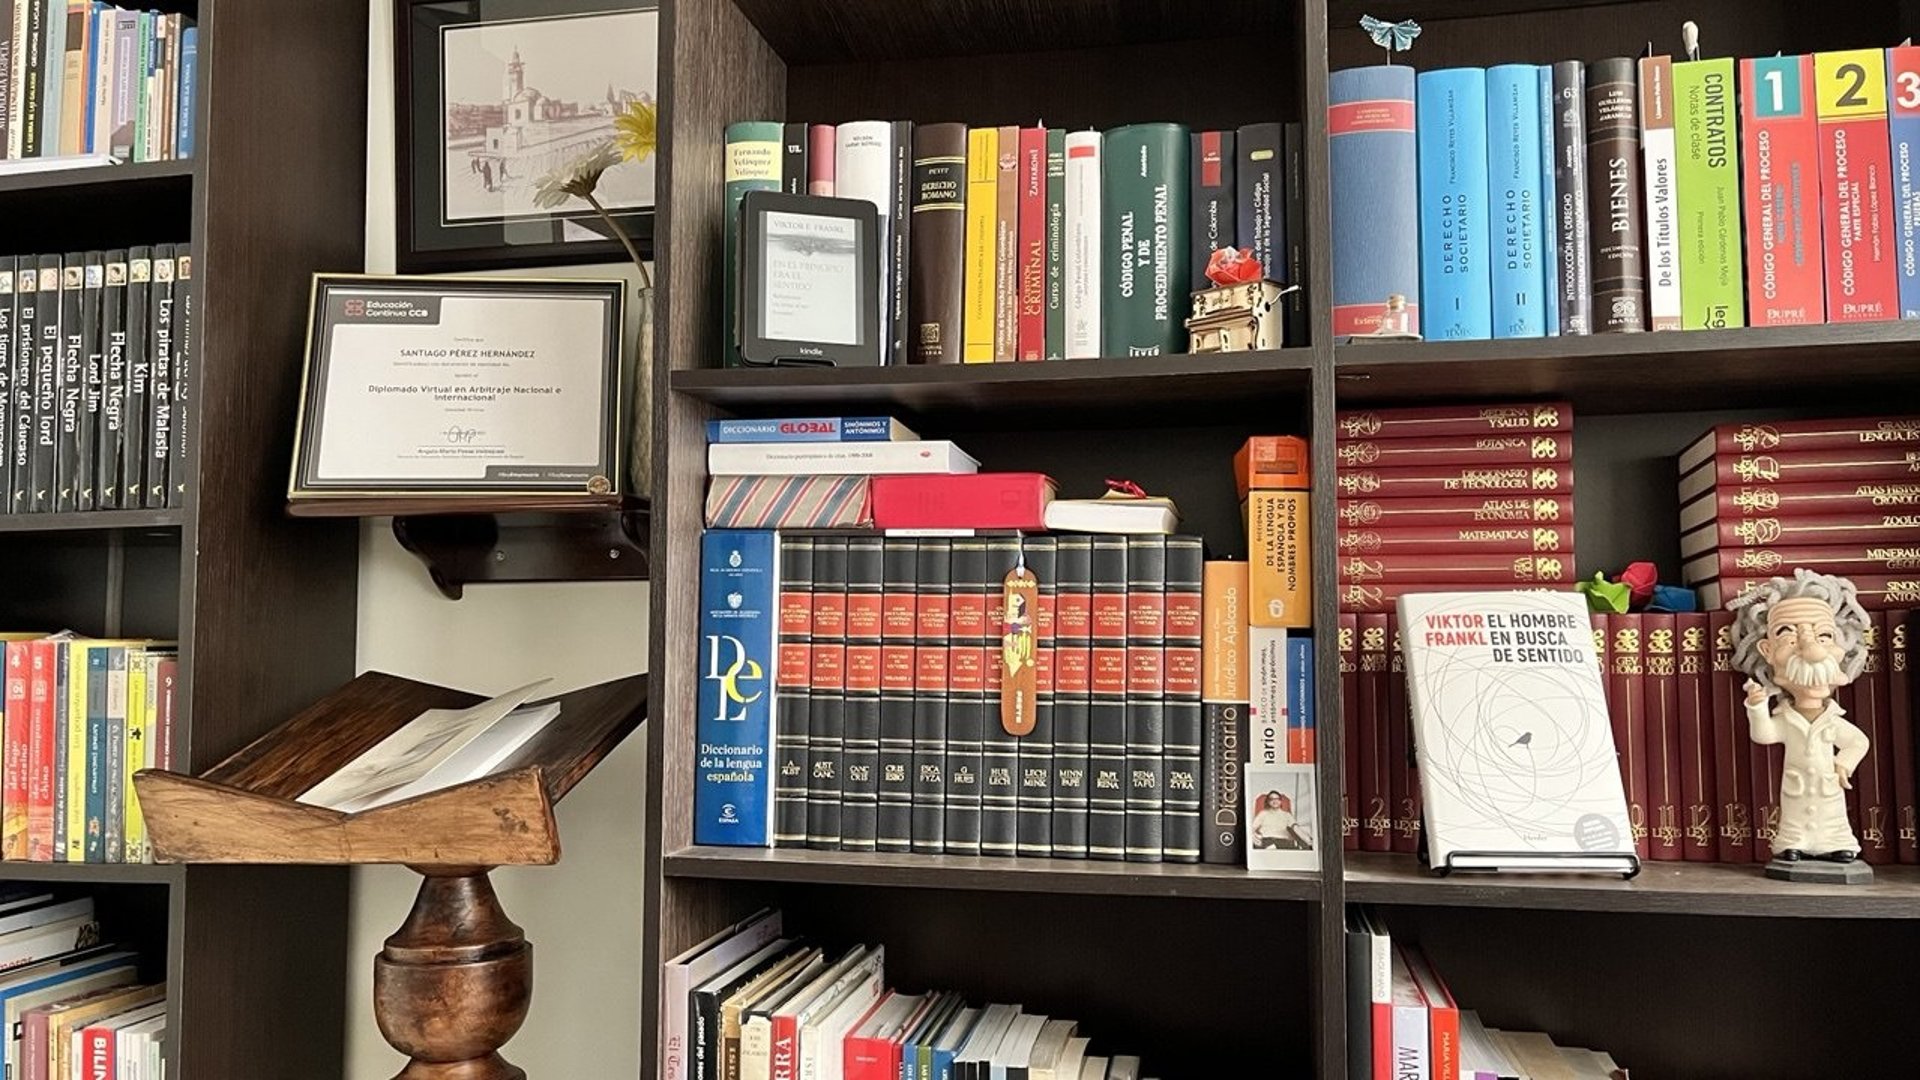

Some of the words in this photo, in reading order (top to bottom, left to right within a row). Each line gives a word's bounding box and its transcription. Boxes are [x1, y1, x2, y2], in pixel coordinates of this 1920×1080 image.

[31, 1, 40, 29] LUCAS
[30, 32, 39, 67] GEORGE
[184, 85, 190, 95] LA
[1765, 71, 1784, 112] 1
[1835, 63, 1868, 107] 2
[1896, 72, 1920, 108] 3
[29, 102, 37, 112] LAS
[184, 96, 190, 106] DE
[1689, 85, 1701, 116] Notas
[182, 129, 189, 138] EL
[1690, 119, 1701, 131] de
[1704, 74, 1727, 168] CONTRATOS
[27, 144, 33, 152] LA
[1691, 133, 1702, 160] clase
[1759, 130, 1771, 181] PROCESO
[1835, 129, 1848, 178] PROCESO
[1899, 142, 1911, 182] PROCESO
[921, 181, 957, 191] DERECHO
[1655, 158, 1669, 202] Valores
[1838, 180, 1850, 198] DEL
[1868, 165, 1877, 190] Blanco
[921, 190, 956, 199] ROMANO
[1155, 184, 1167, 223] PENAL
[1253, 182, 1261, 207] Código
[1609, 157, 1631, 232] BIENES
[1716, 186, 1726, 204] Juan
[1760, 183, 1772, 200] DEL
[1851, 181, 1861, 217] ESPECIAL
[1869, 191, 1880, 212] López
[1902, 184, 1913, 200] DEL
[1209, 200, 1218, 239] Colombia
[1262, 194, 1272, 228] Seguridad
[1563, 193, 1573, 230] DERECHO
[1717, 206, 1727, 227] Pablo
[1840, 200, 1853, 248] GENERAL
[1870, 213, 1880, 234] Fabio
[1903, 202, 1914, 237] GENERAL
[1050, 203, 1061, 261] criminología
[1121, 212, 1133, 250] PENAL
[1254, 214, 1264, 239] Trabajo
[1442, 194, 1454, 274] DERECHO
[1457, 193, 1469, 273] SOCIETARIO
[1505, 189, 1517, 270] DERECHO
[1521, 190, 1532, 269] SOCIETARIO
[1564, 231, 1573, 240] AL
[1656, 206, 1671, 248] Títulos
[1761, 202, 1774, 250] GENERAL
[1853, 218, 1863, 241] PARTE
[1138, 239, 1150, 256] DE
[1210, 240, 1217, 250] de
[1263, 238, 1270, 246] de
[1718, 229, 1729, 265] Cárdenas
[1872, 235, 1881, 261] Hernán
[1138, 257, 1150, 267] Y
[1563, 242, 1575, 301] INTRODUCCIÓN
[1657, 251, 1671, 268] los
[1905, 240, 1916, 276] CÓDIGO
[1030, 240, 1042, 315] CRIMINAL
[1051, 266, 1059, 278] de
[1119, 252, 1133, 297] CÓDIGO
[1155, 225, 1167, 320] PROCEDIMIENTO
[1658, 271, 1672, 286] De
[1718, 267, 1730, 287] Mejía
[1761, 253, 1776, 299] CÓDIGO
[1838, 250, 1855, 296] CÓDIGO
[1050, 282, 1059, 309] Curso
[22, 307, 34, 319] El
[159, 299, 173, 324] Los
[366, 309, 407, 317] Continua
[43, 325, 56, 339] El
[20, 324, 32, 386] prisionero
[66, 335, 81, 382] Flecha
[110, 332, 124, 380] Flecha
[156, 330, 171, 377] piratas
[450, 349, 478, 358] PÉREZ
[480, 349, 535, 358] HERNÁNDEZ
[800, 347, 823, 356] kindle
[40, 346, 55, 410] pequeño
[88, 354, 101, 384] Lord
[133, 362, 148, 393] Kim
[19, 391, 31, 410] del
[88, 389, 100, 412] Jim
[157, 383, 170, 400] de
[368, 385, 418, 394] Diplomado
[421, 385, 452, 393] Virtual
[468, 385, 511, 396] Arbitraje
[513, 386, 553, 394] Nacional
[62, 388, 78, 432] Negra
[107, 386, 123, 430] Negra
[40, 416, 54, 445] lord
[155, 405, 170, 458] Malasia
[723, 424, 776, 435] DICCIONARIO
[779, 422, 836, 434] GLOBAL
[844, 420, 880, 428] SINÓNIMOS
[845, 426, 886, 435] ANTÓNIMOS
[17, 415, 30, 466] Cáucaso
[1266, 498, 1274, 536] LENGUA
[1277, 499, 1284, 509] DE
[1474, 511, 1530, 521] ECONOMIA
[1482, 500, 1513, 510] ATLAS
[1514, 500, 1530, 509] DE
[1267, 541, 1274, 551] LA
[1275, 523, 1285, 572] ESPAÑOLA
[1459, 530, 1529, 540] MATEMATICAS
[1267, 554, 1274, 566] DE
[1288, 544, 1296, 591] NOMBRES
[1223, 587, 1237, 645] Aplicado
[1425, 614, 1484, 629] VIKTOR
[1488, 615, 1506, 628] EL
[1509, 614, 1577, 629] HOMBRE
[1425, 632, 1487, 645] FRANKL
[1491, 632, 1511, 645] EN
[1516, 631, 1568, 645] BUSCA
[1493, 649, 1514, 662] DE
[1518, 649, 1584, 663] SENTIDO
[1223, 650, 1237, 698] Jurídico
[10, 741, 19, 768] lago
[702, 744, 763, 756] Diccionario
[700, 758, 712, 768] de
[714, 758, 724, 768] la
[726, 758, 762, 771] lengua
[706, 771, 754, 782] española
[1025, 769, 1047, 778] LECH
[1216, 706, 1237, 827] Diccionario
[41, 765, 49, 799] china
[697, 1016, 707, 1045] pasado
[697, 1046, 705, 1060] del
